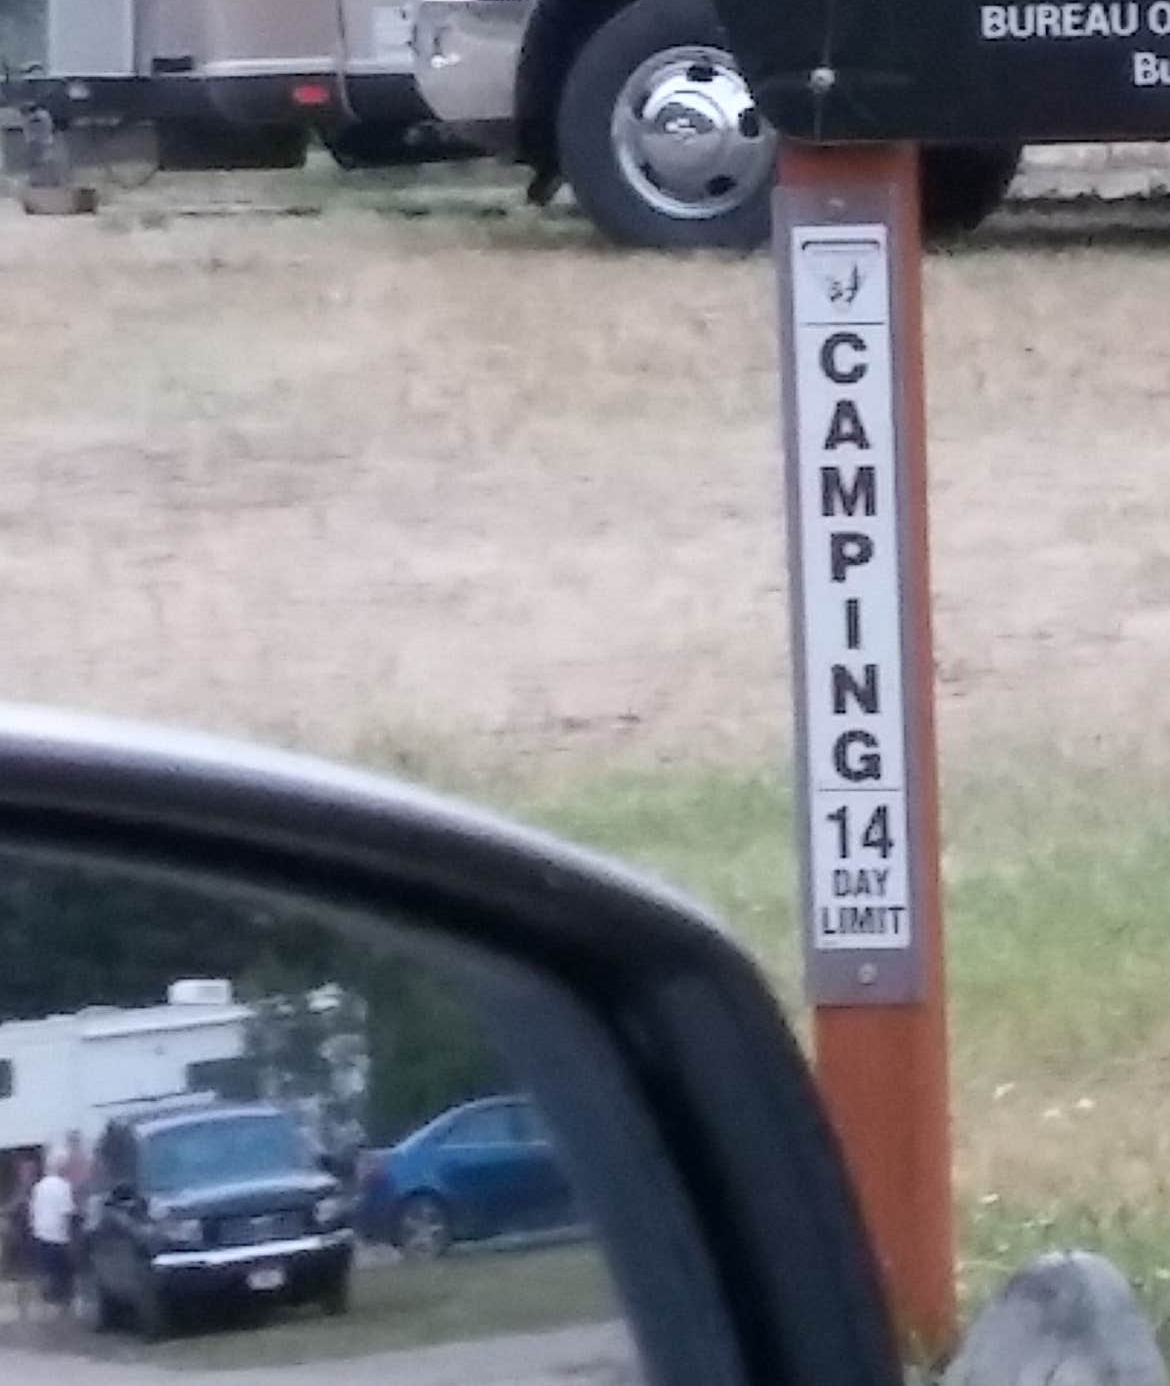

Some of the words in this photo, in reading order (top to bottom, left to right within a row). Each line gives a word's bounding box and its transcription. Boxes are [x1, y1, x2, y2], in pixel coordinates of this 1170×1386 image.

[981, 1, 1139, 40] BUREAU
[818, 331, 882, 783] CAMPING
[826, 804, 894, 860] 14
[832, 868, 889, 898] DAY
[820, 905, 906, 935] LIMIT
